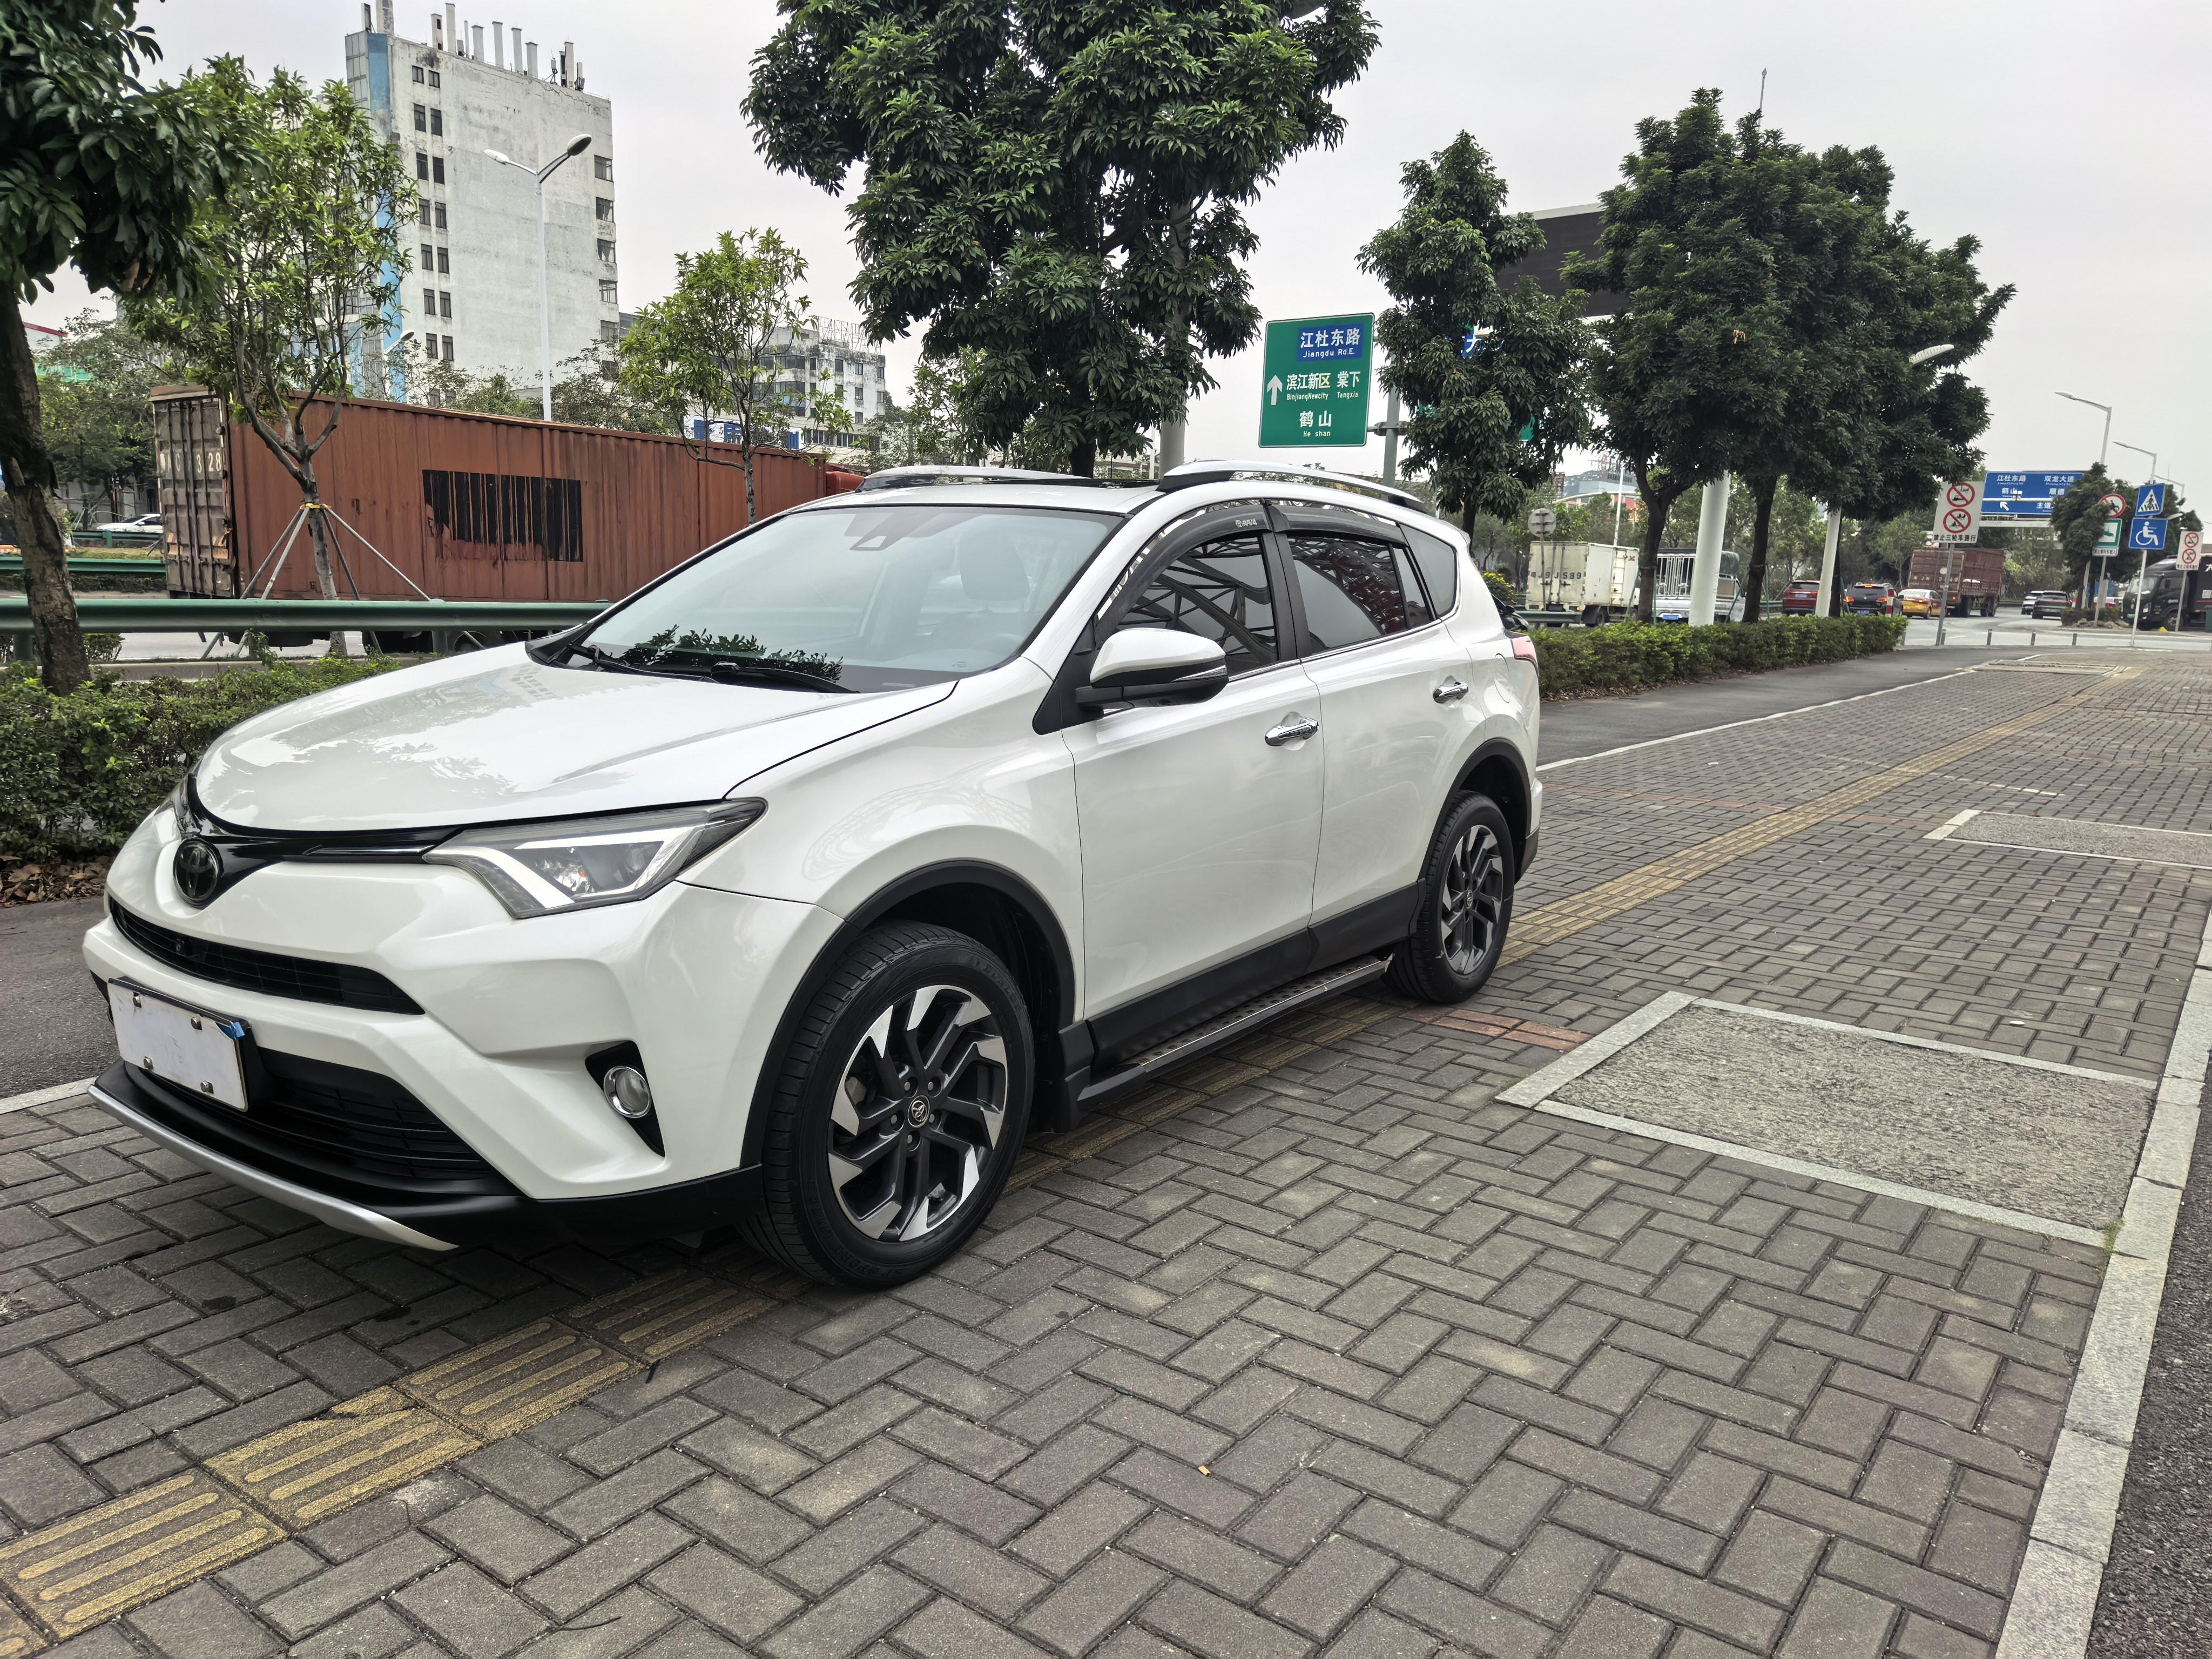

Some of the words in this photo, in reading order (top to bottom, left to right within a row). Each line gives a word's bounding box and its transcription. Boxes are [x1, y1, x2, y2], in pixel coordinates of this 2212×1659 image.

[1300, 327, 1360, 348] 江杜东路
[1303, 350, 1334, 359] Jiangdu
[1286, 373, 1331, 390] 滨江新区
[1337, 370, 1361, 388] 棠下
[1337, 391, 1358, 400] Tangxia
[1299, 410, 1332, 428] 鹤山
